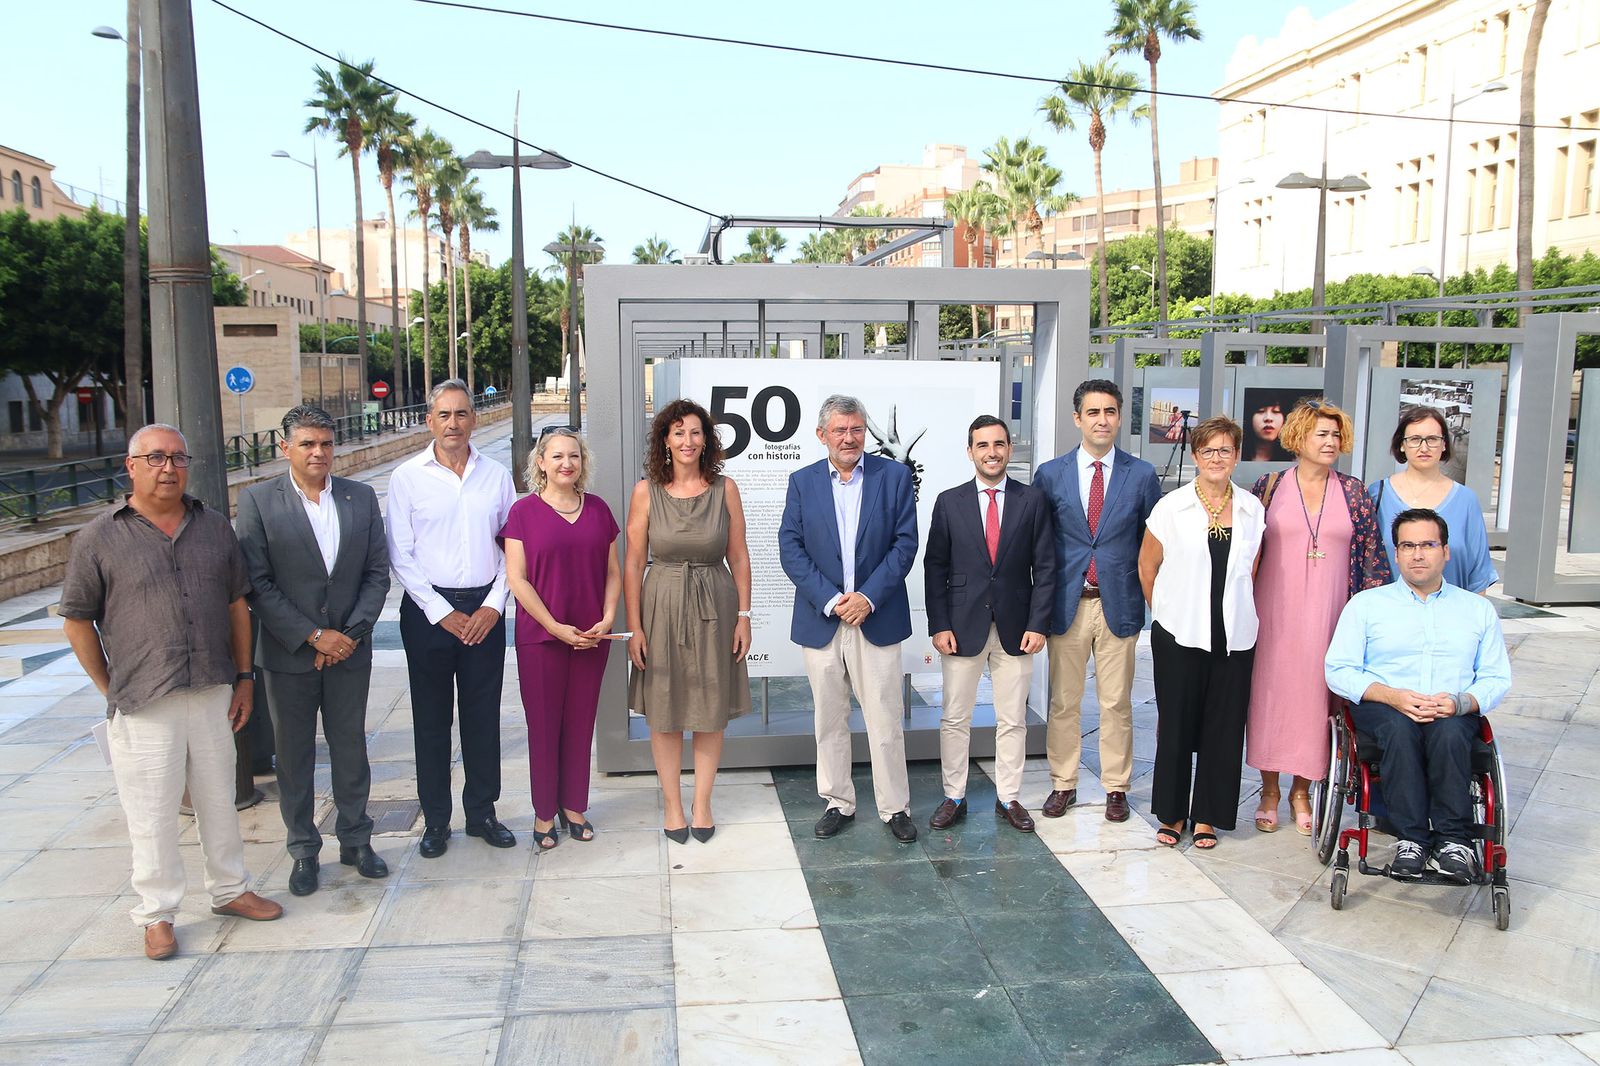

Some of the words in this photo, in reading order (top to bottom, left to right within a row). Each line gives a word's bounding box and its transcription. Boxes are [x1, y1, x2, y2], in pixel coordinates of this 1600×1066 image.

[709, 385, 801, 460] 50
[766, 451, 801, 460] historia
[747, 653, 769, 661] AC/E
